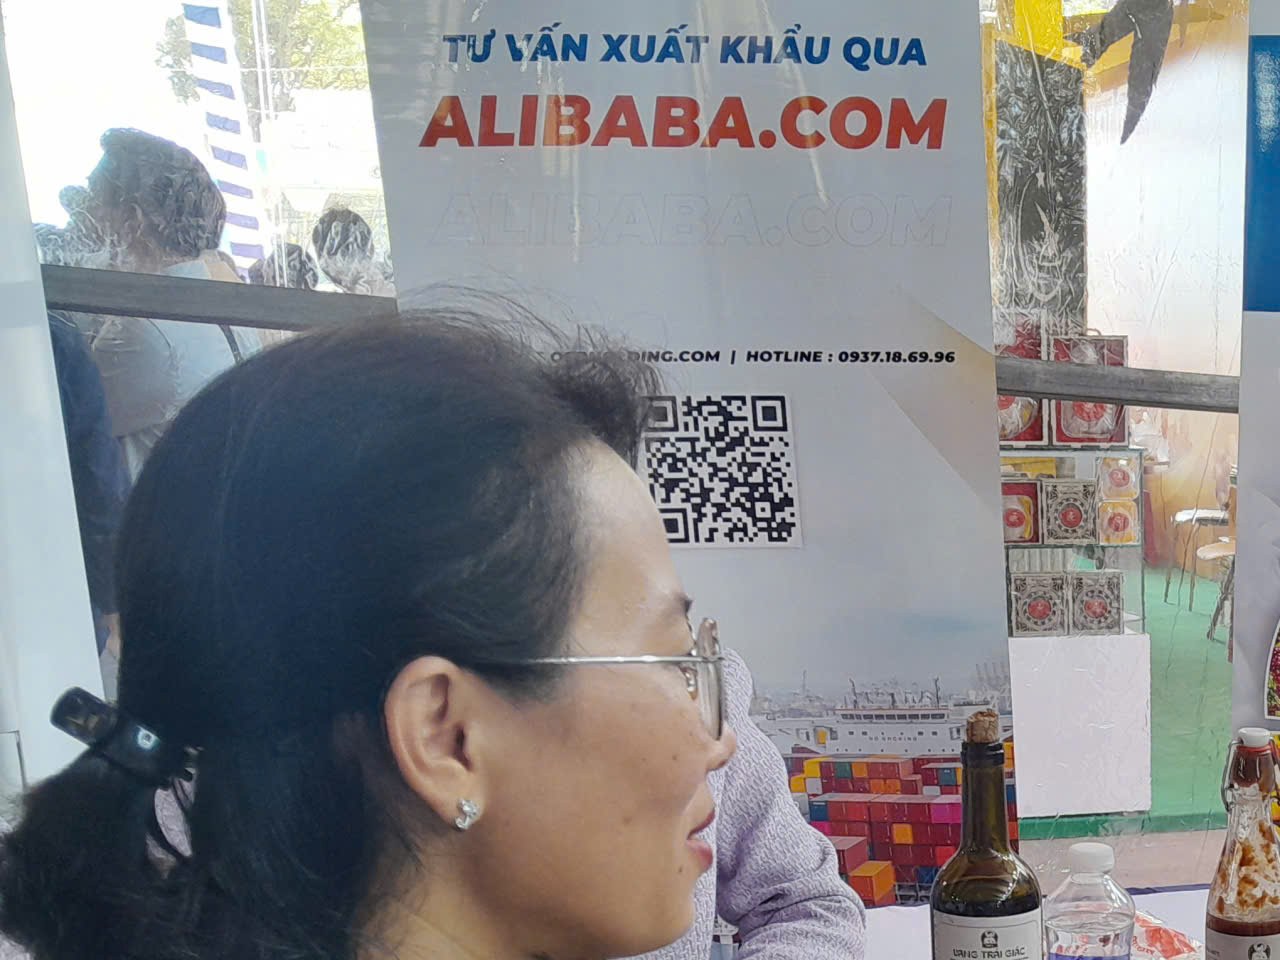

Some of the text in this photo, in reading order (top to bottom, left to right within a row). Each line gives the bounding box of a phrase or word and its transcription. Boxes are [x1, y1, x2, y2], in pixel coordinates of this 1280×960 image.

[443, 22, 928, 71] TƯ VẤN XUẤT KHẨU QUA
[418, 95, 948, 149] ALIBABA.COM
[746, 351, 823, 362] HOTLINE
[838, 351, 955, 363] 0937.18.69.96
